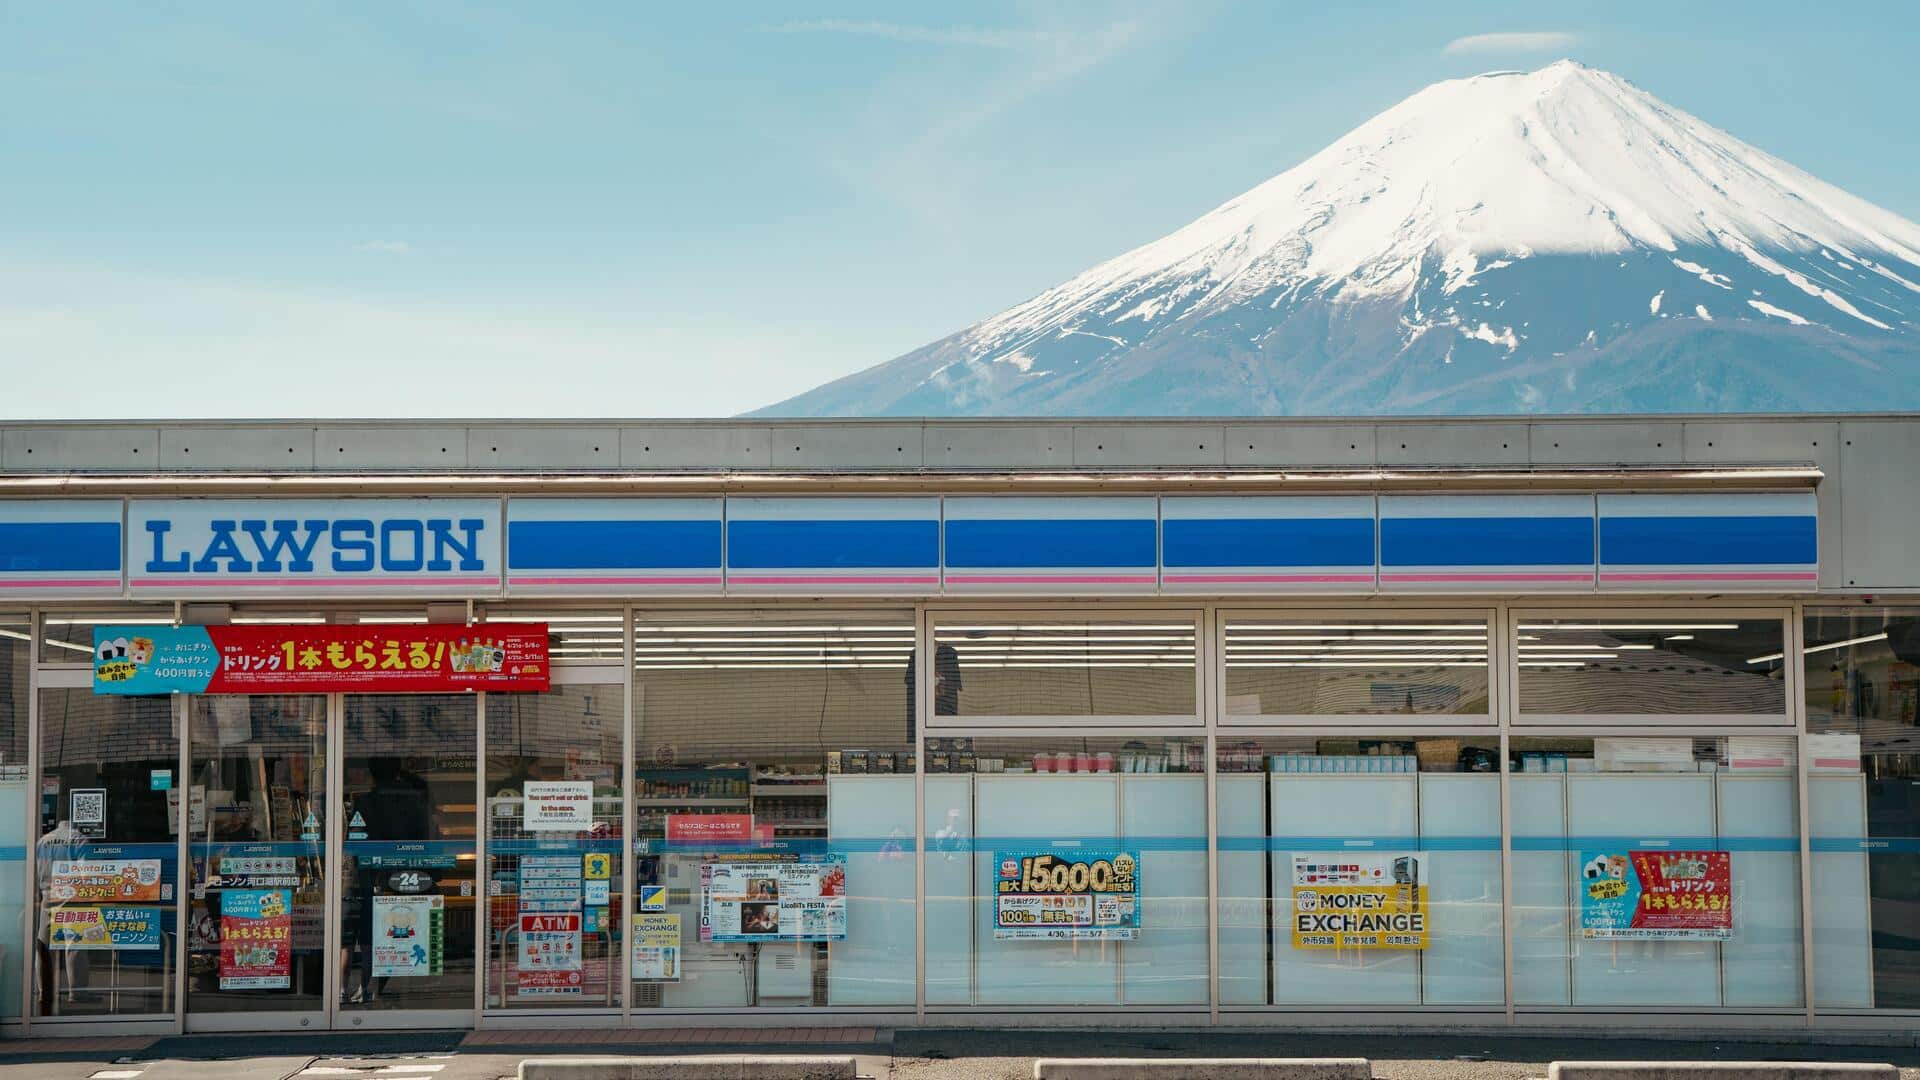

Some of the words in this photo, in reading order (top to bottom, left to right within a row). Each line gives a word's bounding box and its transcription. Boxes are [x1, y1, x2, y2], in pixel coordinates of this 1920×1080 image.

[145, 519, 485, 573] LAWSON
[281, 639, 445, 670] 1本もらえる!
[98, 663, 137, 675] 組み合わせ
[224, 655, 281, 671] ドリンク
[155, 668, 211, 678] 400円買うと
[400, 872, 419, 886] 24
[999, 880, 1020, 892] 最大
[1671, 880, 1715, 893] ドリンク
[1320, 894, 1386, 908] MONEY
[1643, 894, 1728, 910] 1本もらえる!
[55, 911, 98, 923] 自動車税
[106, 910, 151, 920] お支払いは
[107, 921, 155, 932] 好きな時に
[532, 916, 570, 931] ATM
[634, 924, 678, 932] EXCHANGE
[1298, 915, 1423, 932] EXCHANGE
[223, 927, 289, 940] 1本もらえる!
